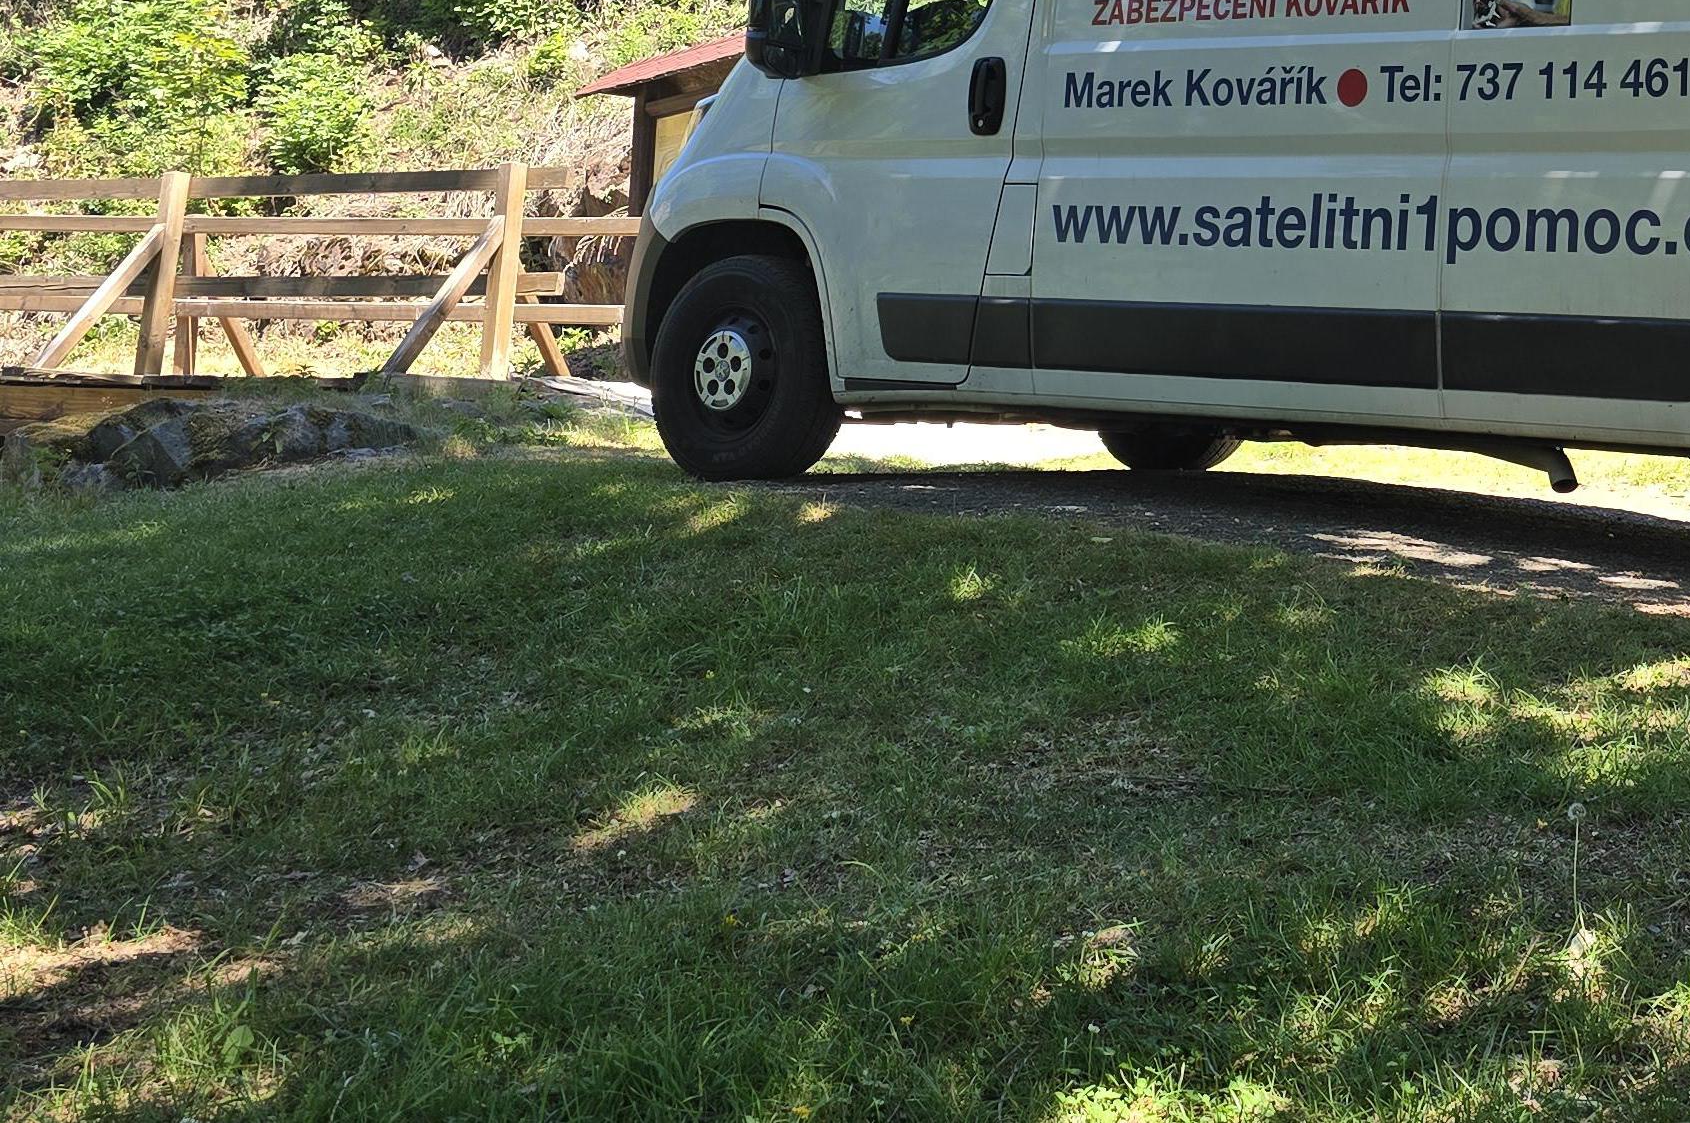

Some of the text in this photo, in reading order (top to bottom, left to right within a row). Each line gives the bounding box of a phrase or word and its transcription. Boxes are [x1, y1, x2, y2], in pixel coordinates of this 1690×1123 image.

[1065, 58, 1688, 108] Marek Kovářík Tel: 737 114 461
